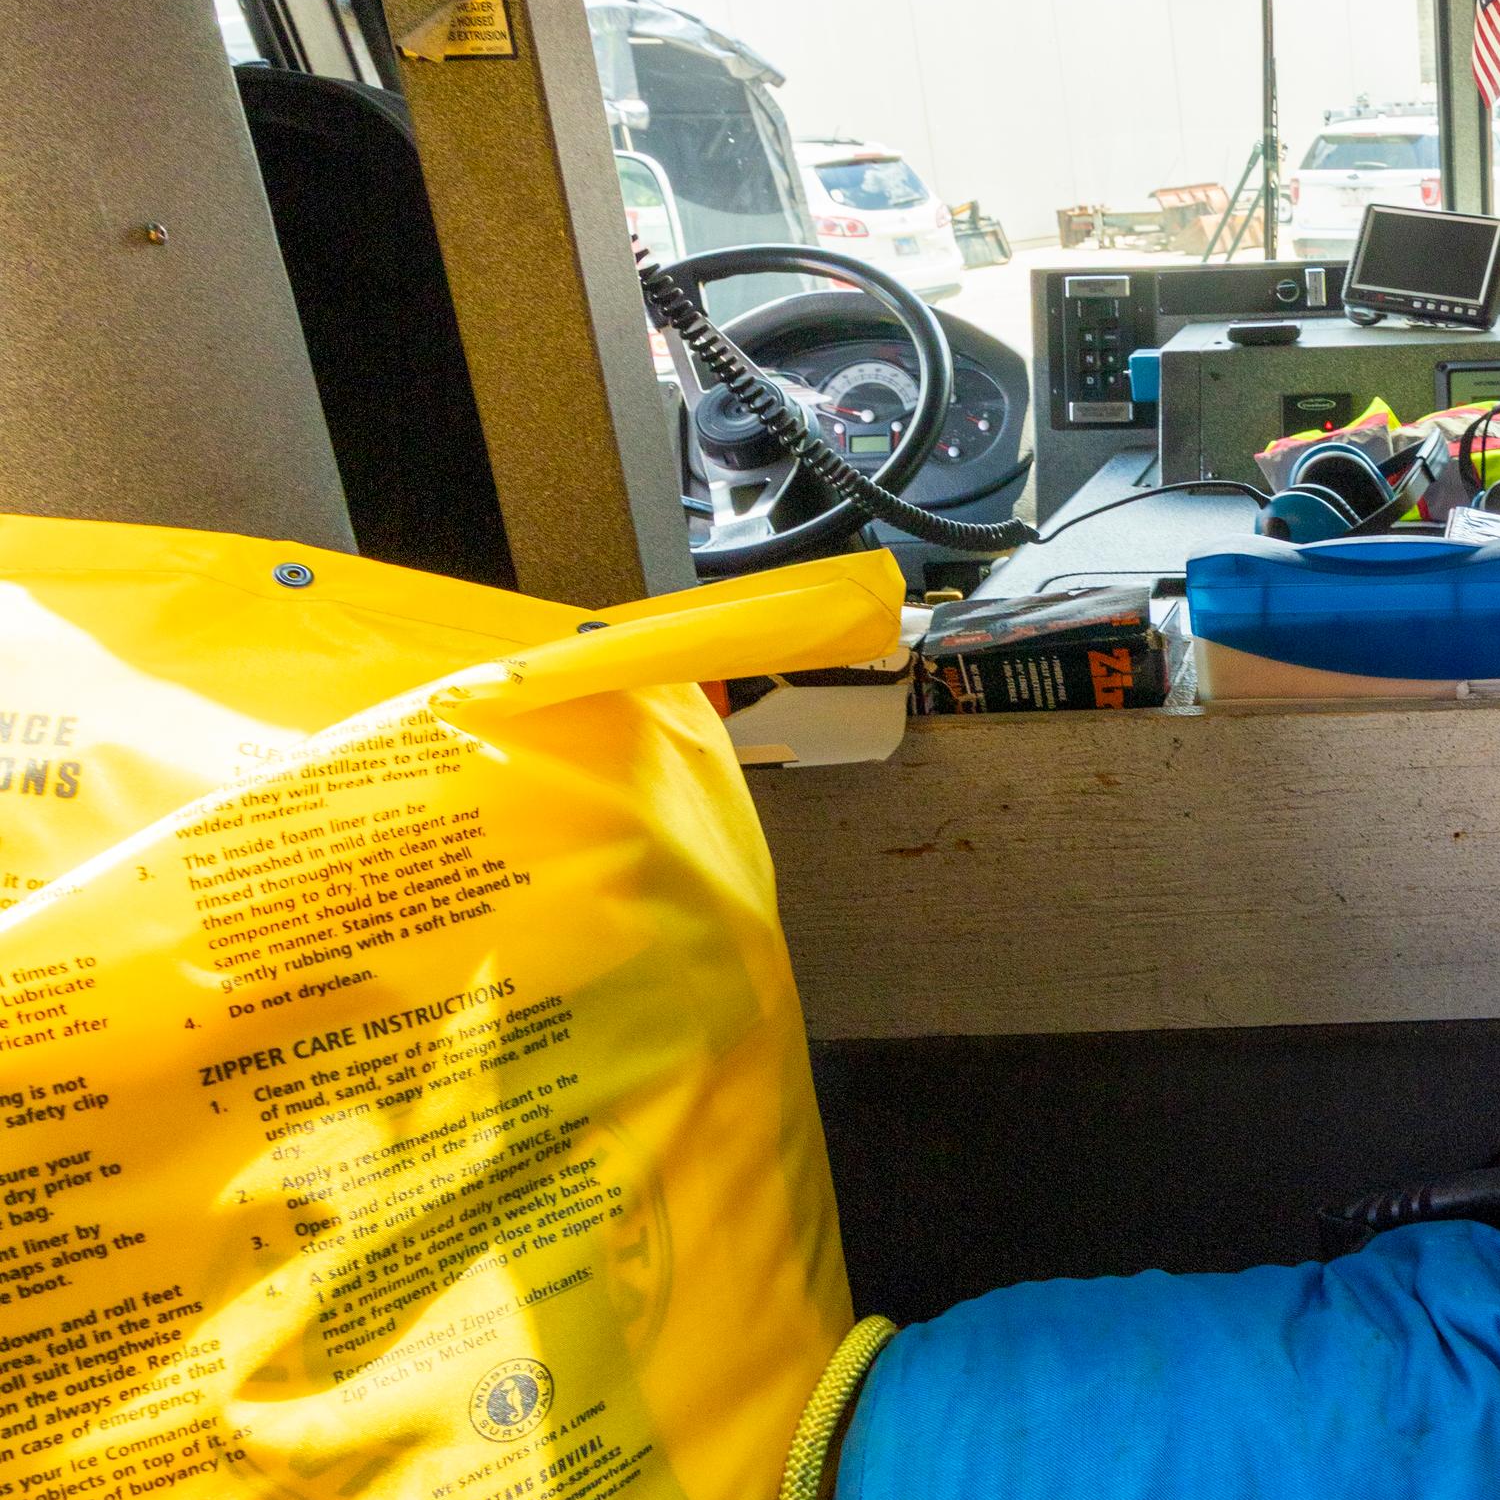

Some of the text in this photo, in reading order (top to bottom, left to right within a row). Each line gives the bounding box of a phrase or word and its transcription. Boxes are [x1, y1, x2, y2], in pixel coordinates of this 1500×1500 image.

[457, 31, 508, 41] EXTRUSION
[209, 857, 506, 950] component should be cleaned in the
[215, 870, 532, 970] same manner. Stains can be cleaned by
[14, 955, 96, 984] times to
[221, 903, 496, 994] gently rubbing with a soft brush.
[3, 977, 96, 1007] Lubricate
[17, 1004, 68, 1023] front
[184, 970, 378, 1031] 4. Do not dryclean.
[63, 1017, 108, 1038] after
[198, 978, 515, 1087] ZIPPER CARE INSTRUCTIONS
[210, 994, 562, 1115] 1. Clean the zipper of any heavy deposits
[6, 1093, 110, 1128] safety clip
[30, 1076, 88, 1100] is not
[4, 1162, 121, 1206] dry prior to
[46, 1151, 91, 1176] your
[9, 1206, 54, 1227] bag.
[23, 1224, 101, 1254] liner by
[51, 1231, 146, 1268] along the
[17, 1274, 73, 1299] boot.
[1, 1285, 183, 1351] down and roll feet
[48, 1301, 203, 1358] fold in the arms
[25, 1339, 222, 1409] the outside. Replace
[33, 1329, 182, 1384] suit lengthwise
[1, 1358, 227, 1440] and always ensure that
[22, 1389, 206, 1455] case of emergency.
[19, 1415, 219, 1493] your Ice Commander
[113, 1465, 136, 1480] on
[143, 1451, 175, 1471] top
[182, 1440, 200, 1456] of
[207, 1435, 227, 1450] it,
[233, 1426, 253, 1440] as
[130, 1456, 219, 1494] buoyancy
[226, 1449, 246, 1464] to
[432, 1401, 605, 1499] WE SAVE LIVES FOR A LIVING
[541, 1436, 604, 1484] SURVIVAL
